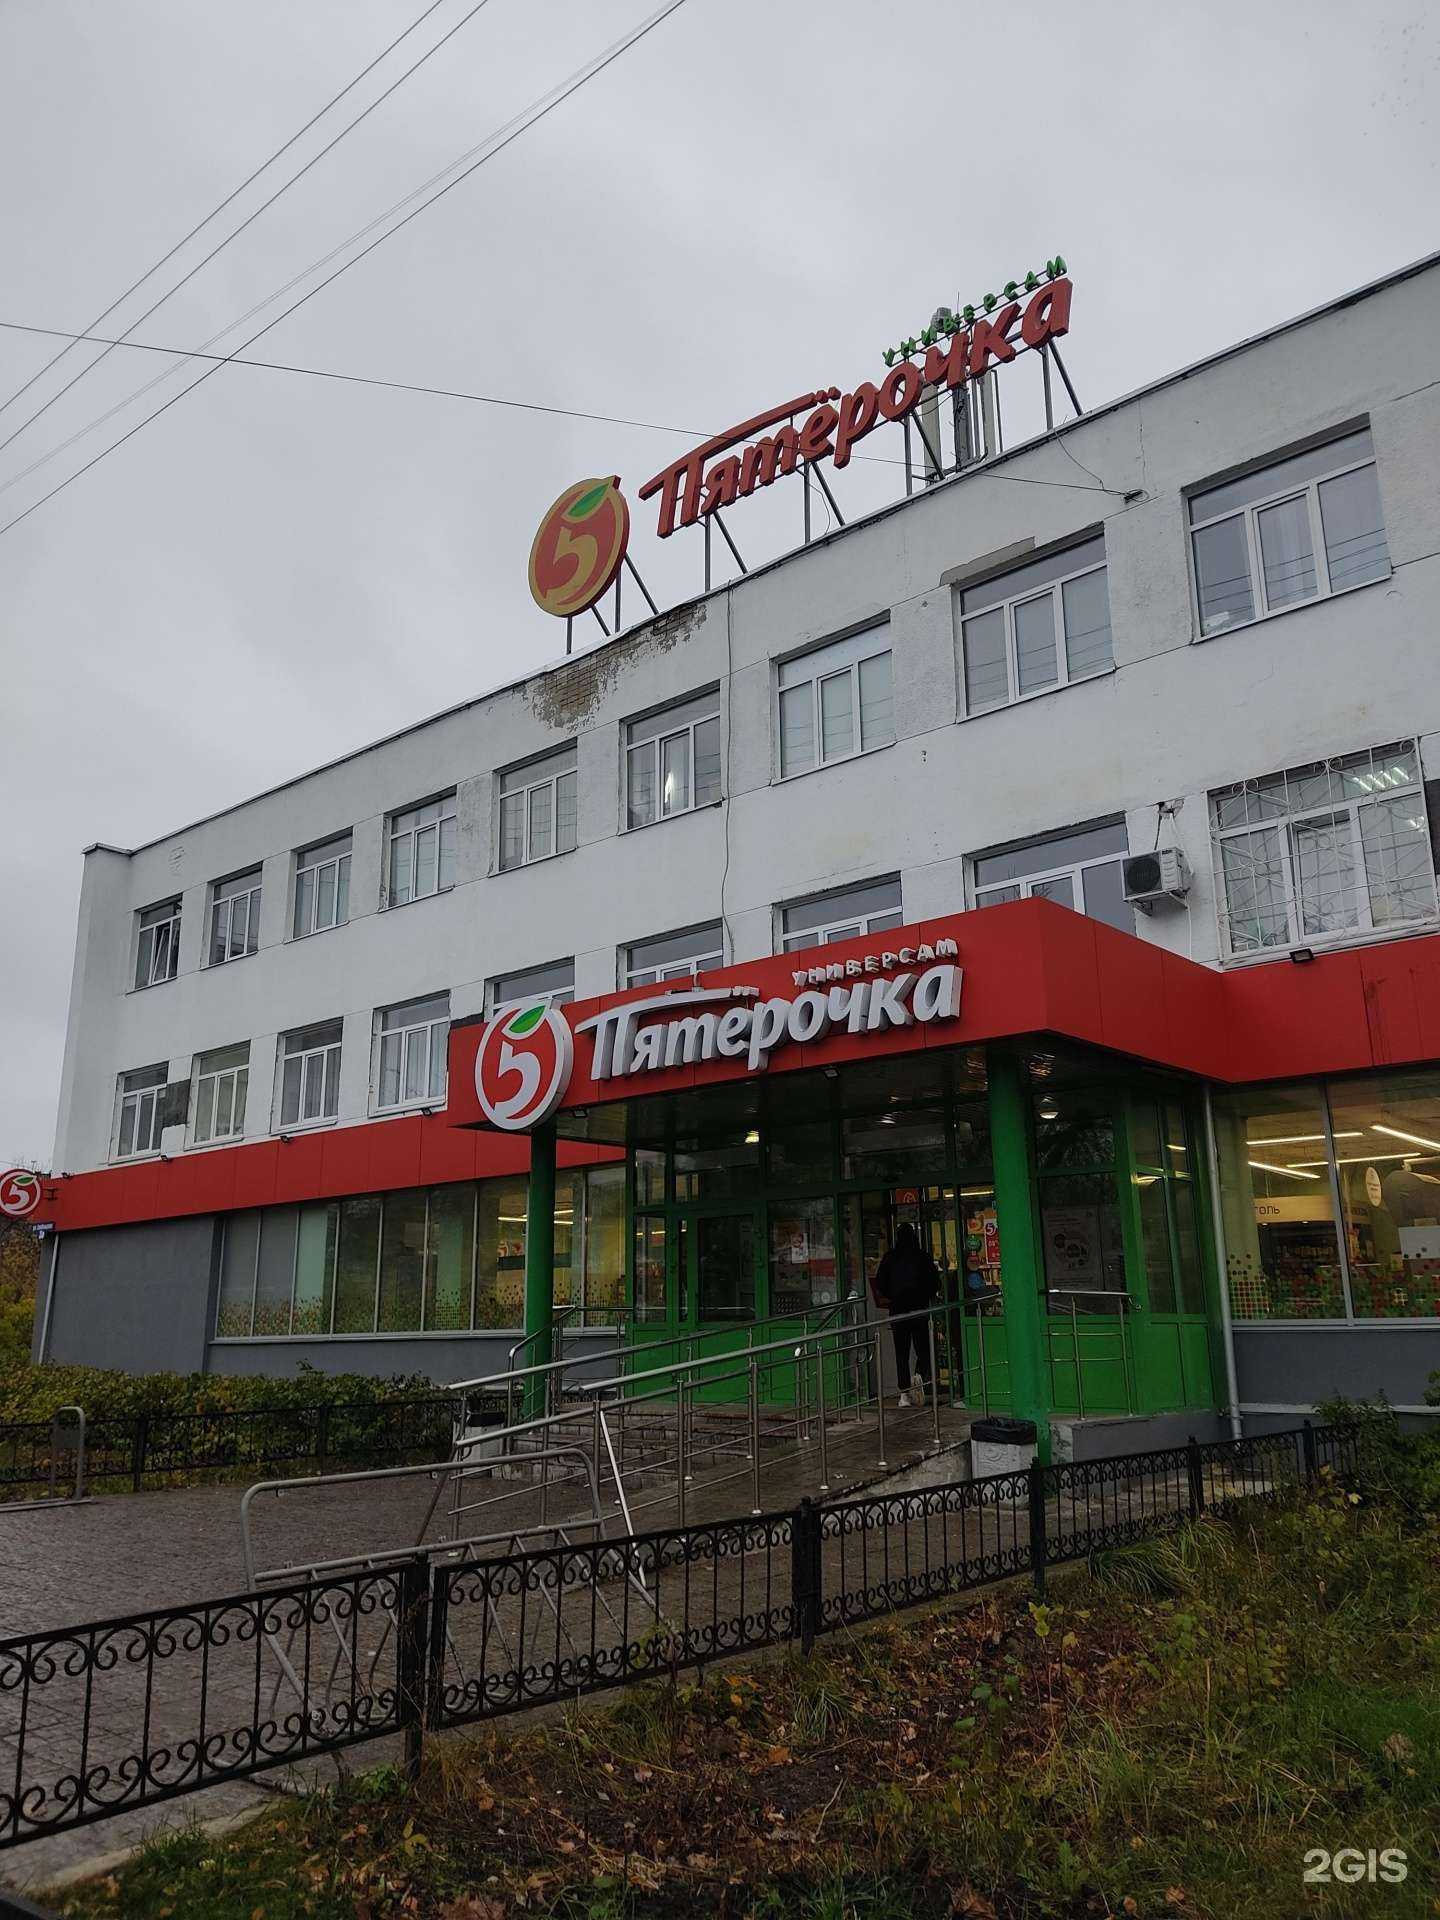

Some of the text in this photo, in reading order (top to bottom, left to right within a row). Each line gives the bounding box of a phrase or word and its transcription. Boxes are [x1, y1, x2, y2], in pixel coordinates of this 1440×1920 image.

[882, 255, 1067, 367] УНИВЕРСАМ
[638, 277, 1073, 538] Пятёрочка
[792, 937, 959, 987] УНИВЕРСАМ
[494, 1040, 541, 1114] 5
[574, 964, 964, 1081] Пятёрочка
